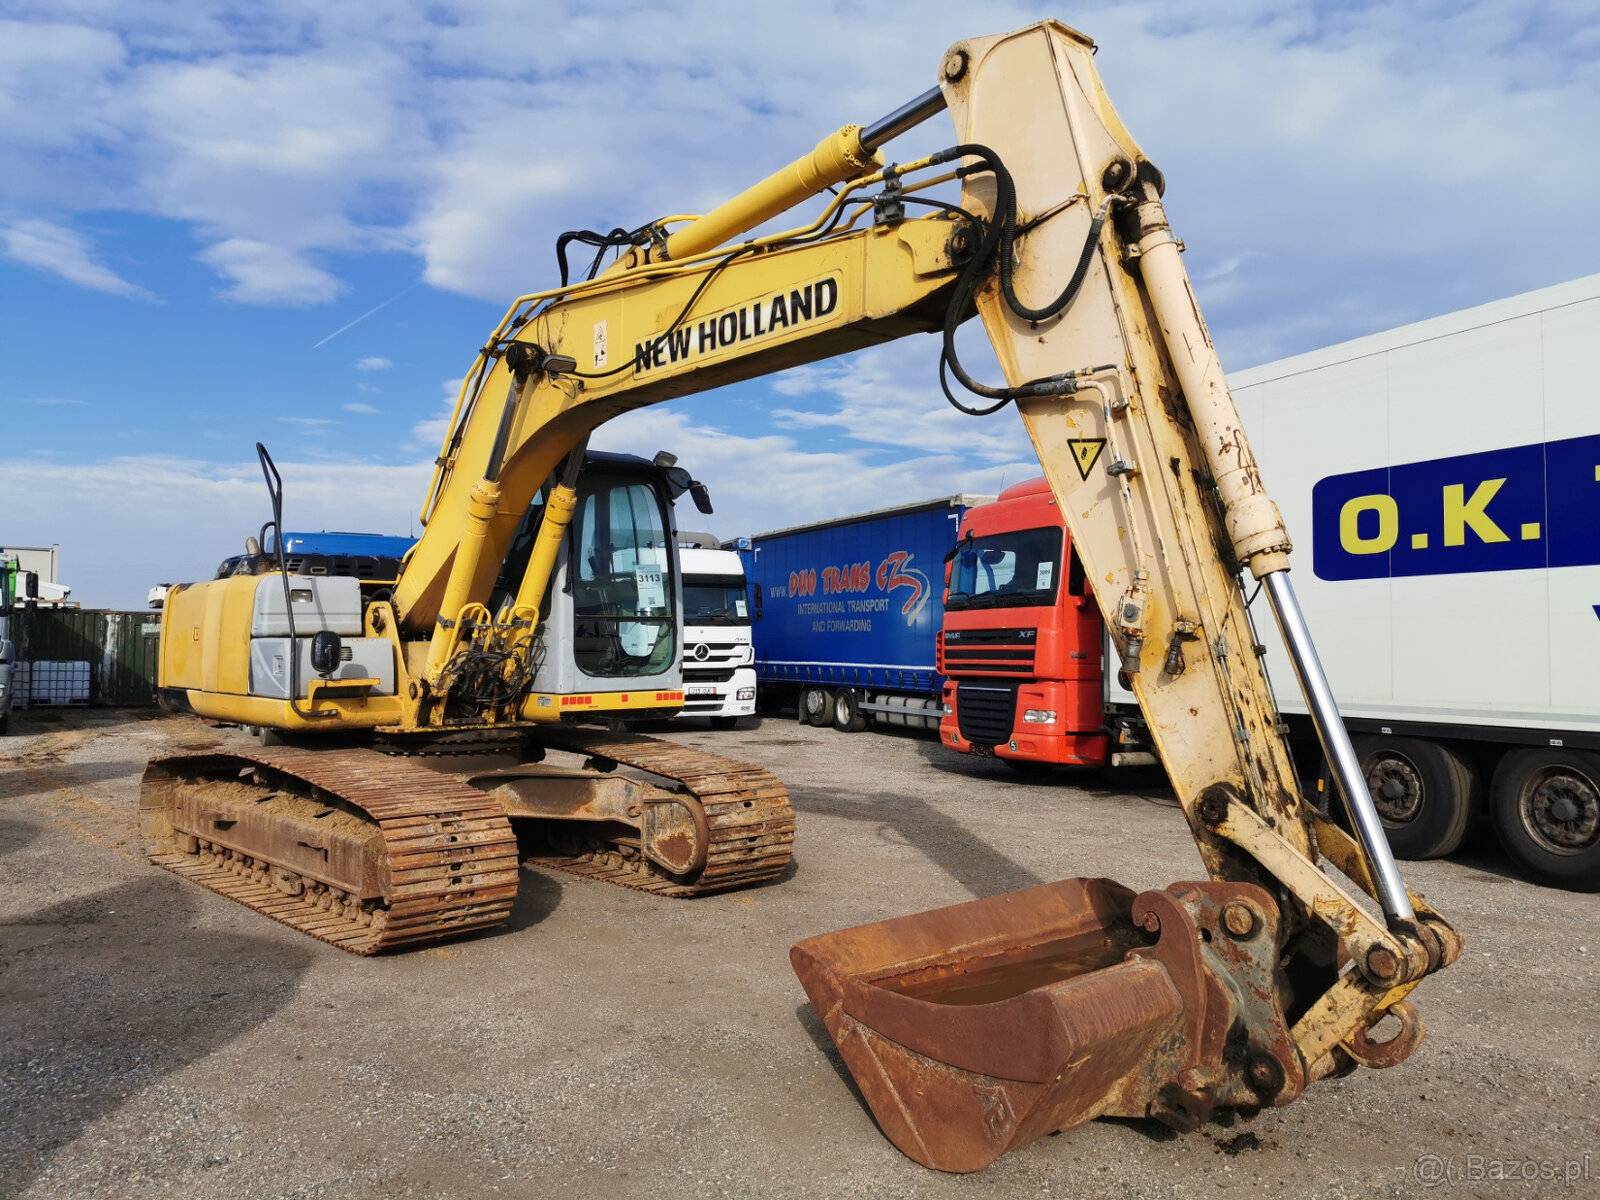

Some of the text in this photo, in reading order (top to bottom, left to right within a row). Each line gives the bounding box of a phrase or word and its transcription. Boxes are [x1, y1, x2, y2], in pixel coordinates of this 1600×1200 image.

[634, 277, 838, 374] NEW HOLLAND
[1340, 477, 1541, 555] O.K.
[638, 574, 661, 582] 3113
[821, 561, 870, 595] TRANS
[797, 598, 890, 615] INTERNATIONAL TRANSPORT
[812, 619, 871, 632] AND FORWARDING
[945, 630, 1036, 640] DAF XF
